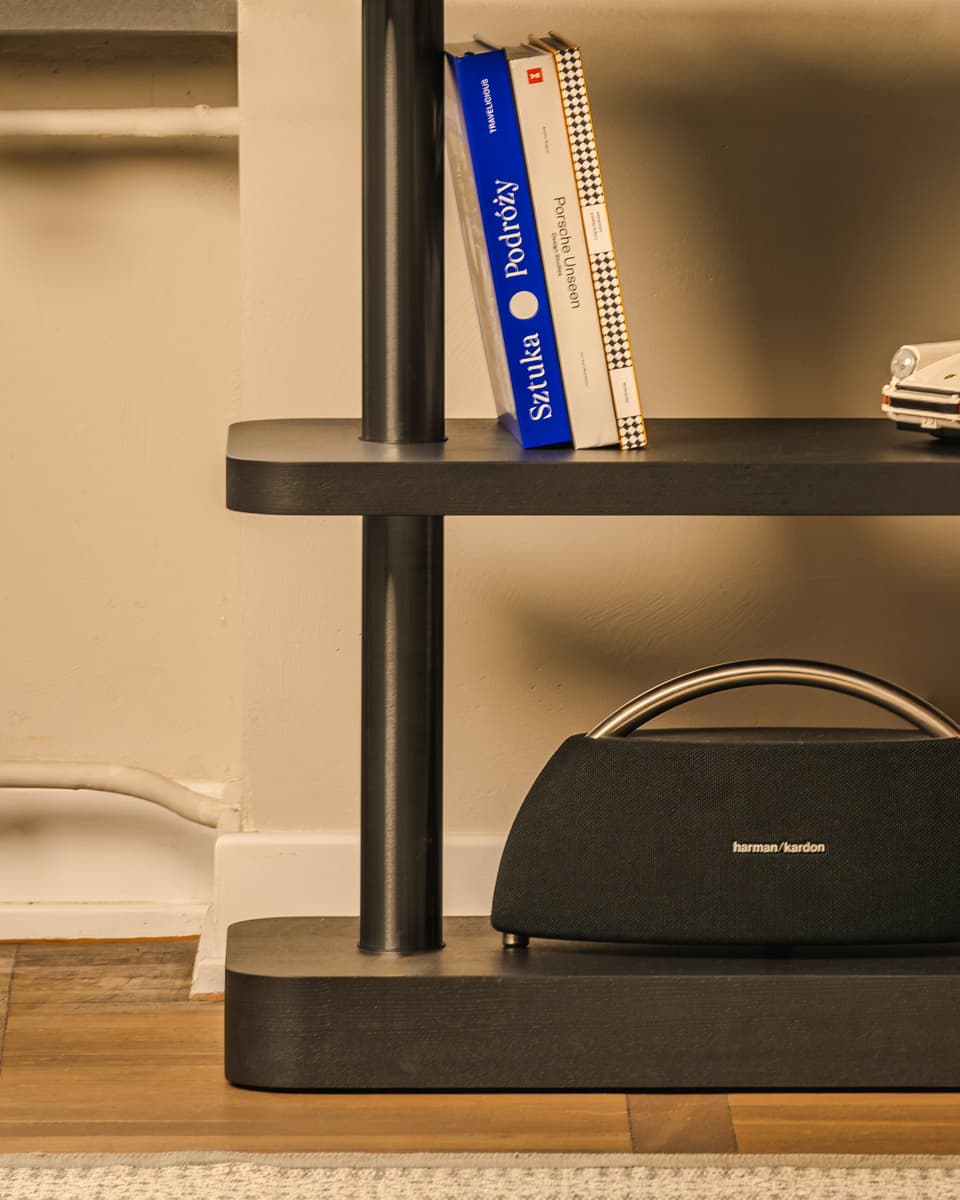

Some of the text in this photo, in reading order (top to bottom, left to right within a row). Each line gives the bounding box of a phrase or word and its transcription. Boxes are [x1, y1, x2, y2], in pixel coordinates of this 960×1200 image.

[481, 78, 497, 135] TRAVELICIOUS
[553, 197, 581, 310] Porsche Unseen
[495, 179, 553, 421] Sztuka Podróży
[732, 841, 826, 853] harman/kardon
